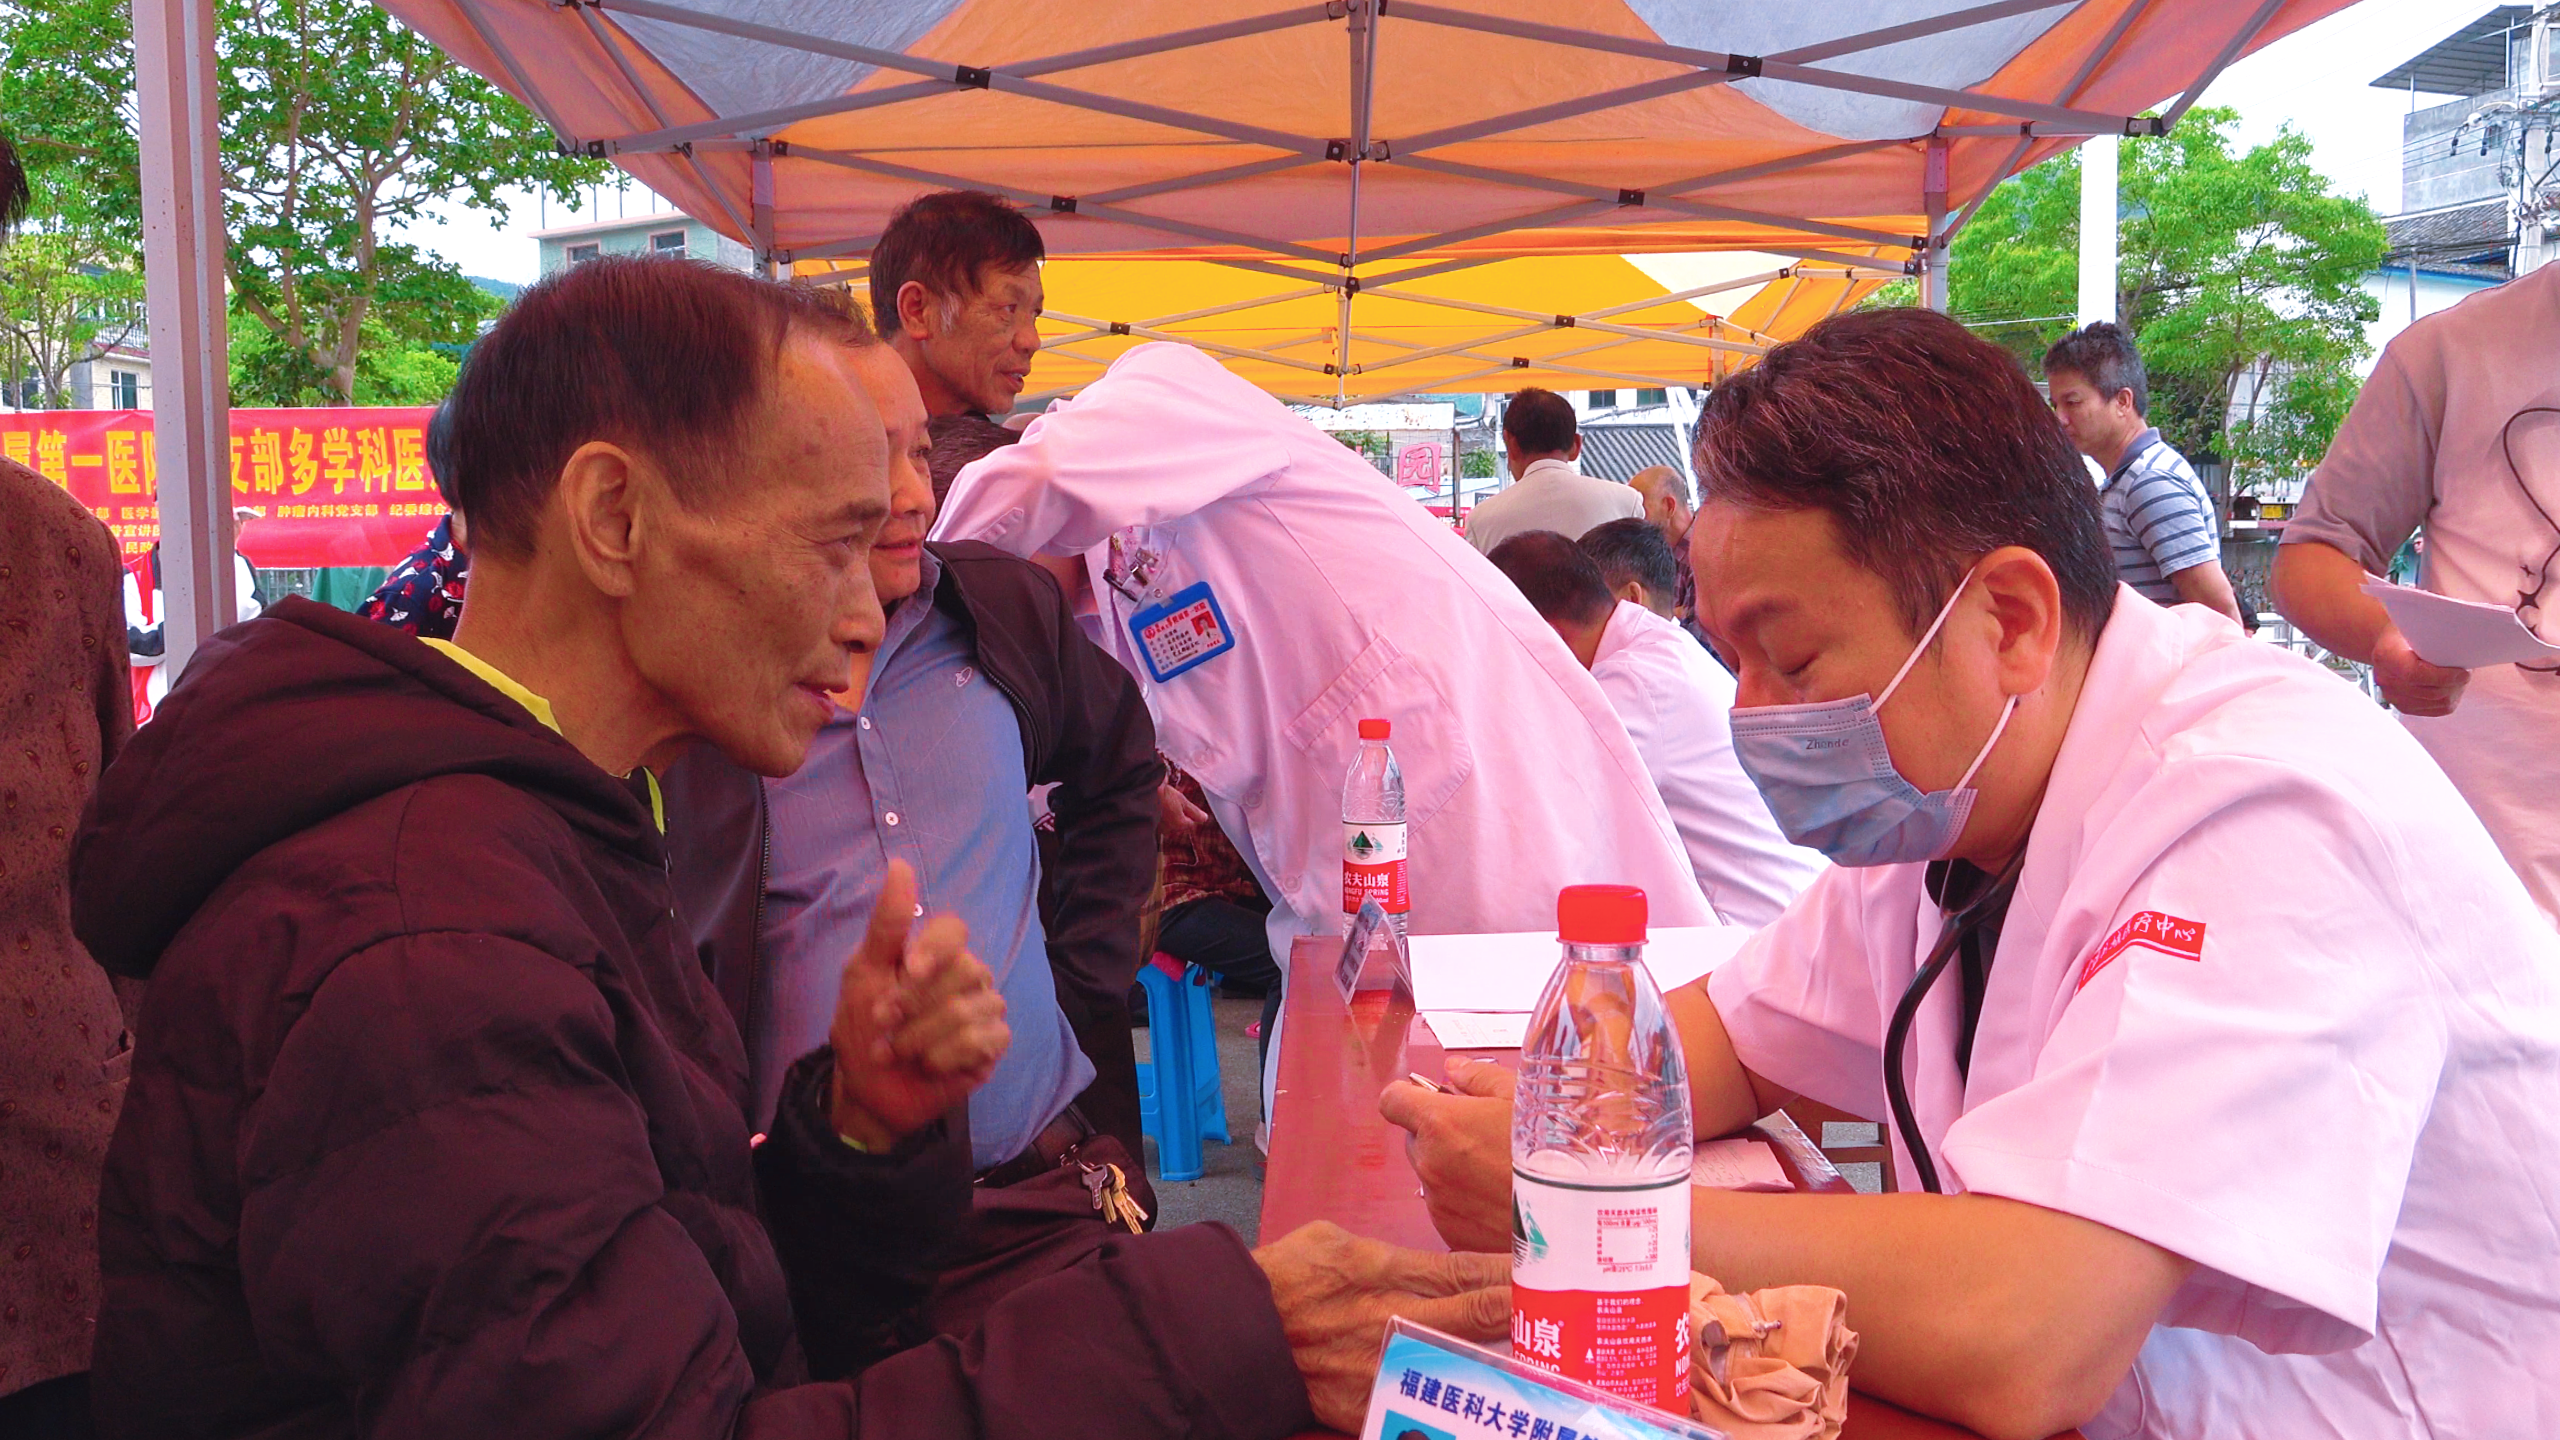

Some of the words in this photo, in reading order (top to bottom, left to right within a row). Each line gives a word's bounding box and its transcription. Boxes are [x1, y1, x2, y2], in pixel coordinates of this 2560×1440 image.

[231, 426, 438, 496] 部多学科医
[277, 504, 378, 518] 肿瘤内科党支部
[1511, 1308, 1562, 1359] 山泉
[1400, 1368, 1600, 1440] 福建医科大学附
